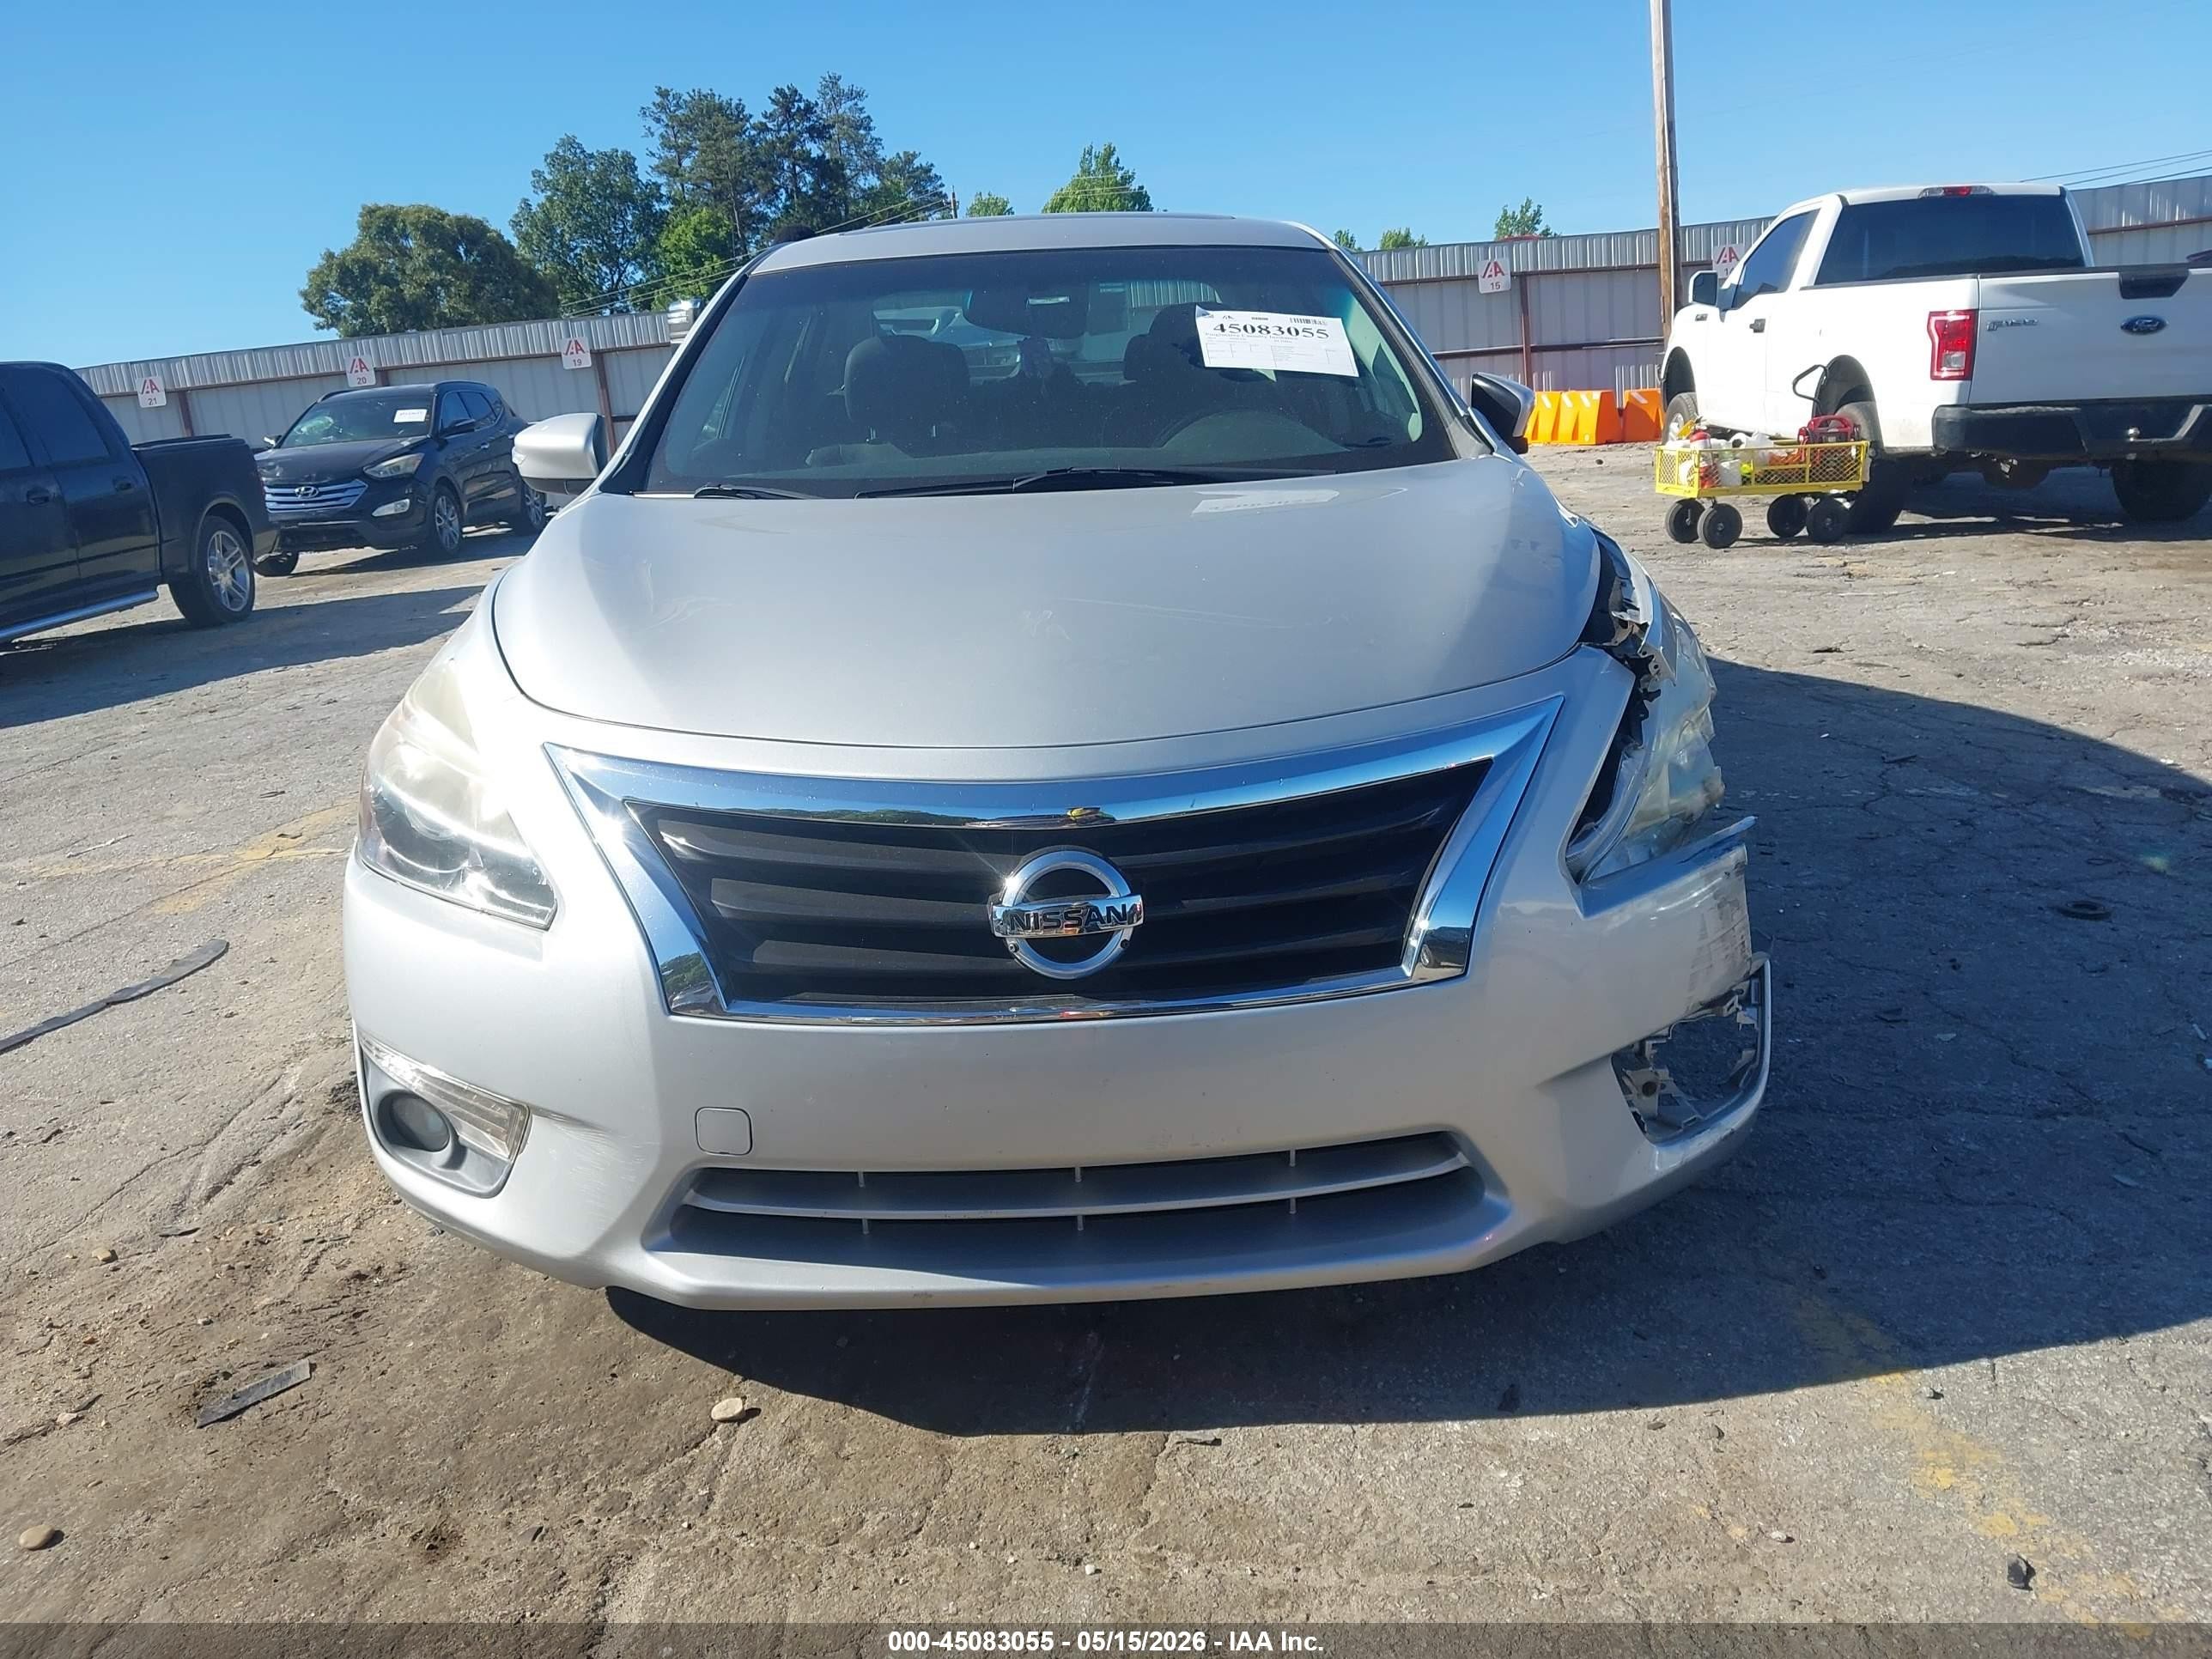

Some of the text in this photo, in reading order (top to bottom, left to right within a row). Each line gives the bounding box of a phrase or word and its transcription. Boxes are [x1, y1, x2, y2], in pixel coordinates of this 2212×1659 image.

[1491, 282, 1501, 290] 15
[1213, 323, 1330, 340] 45083055
[573, 358, 582, 367] 19
[1009, 903, 1128, 932] NISSAN
